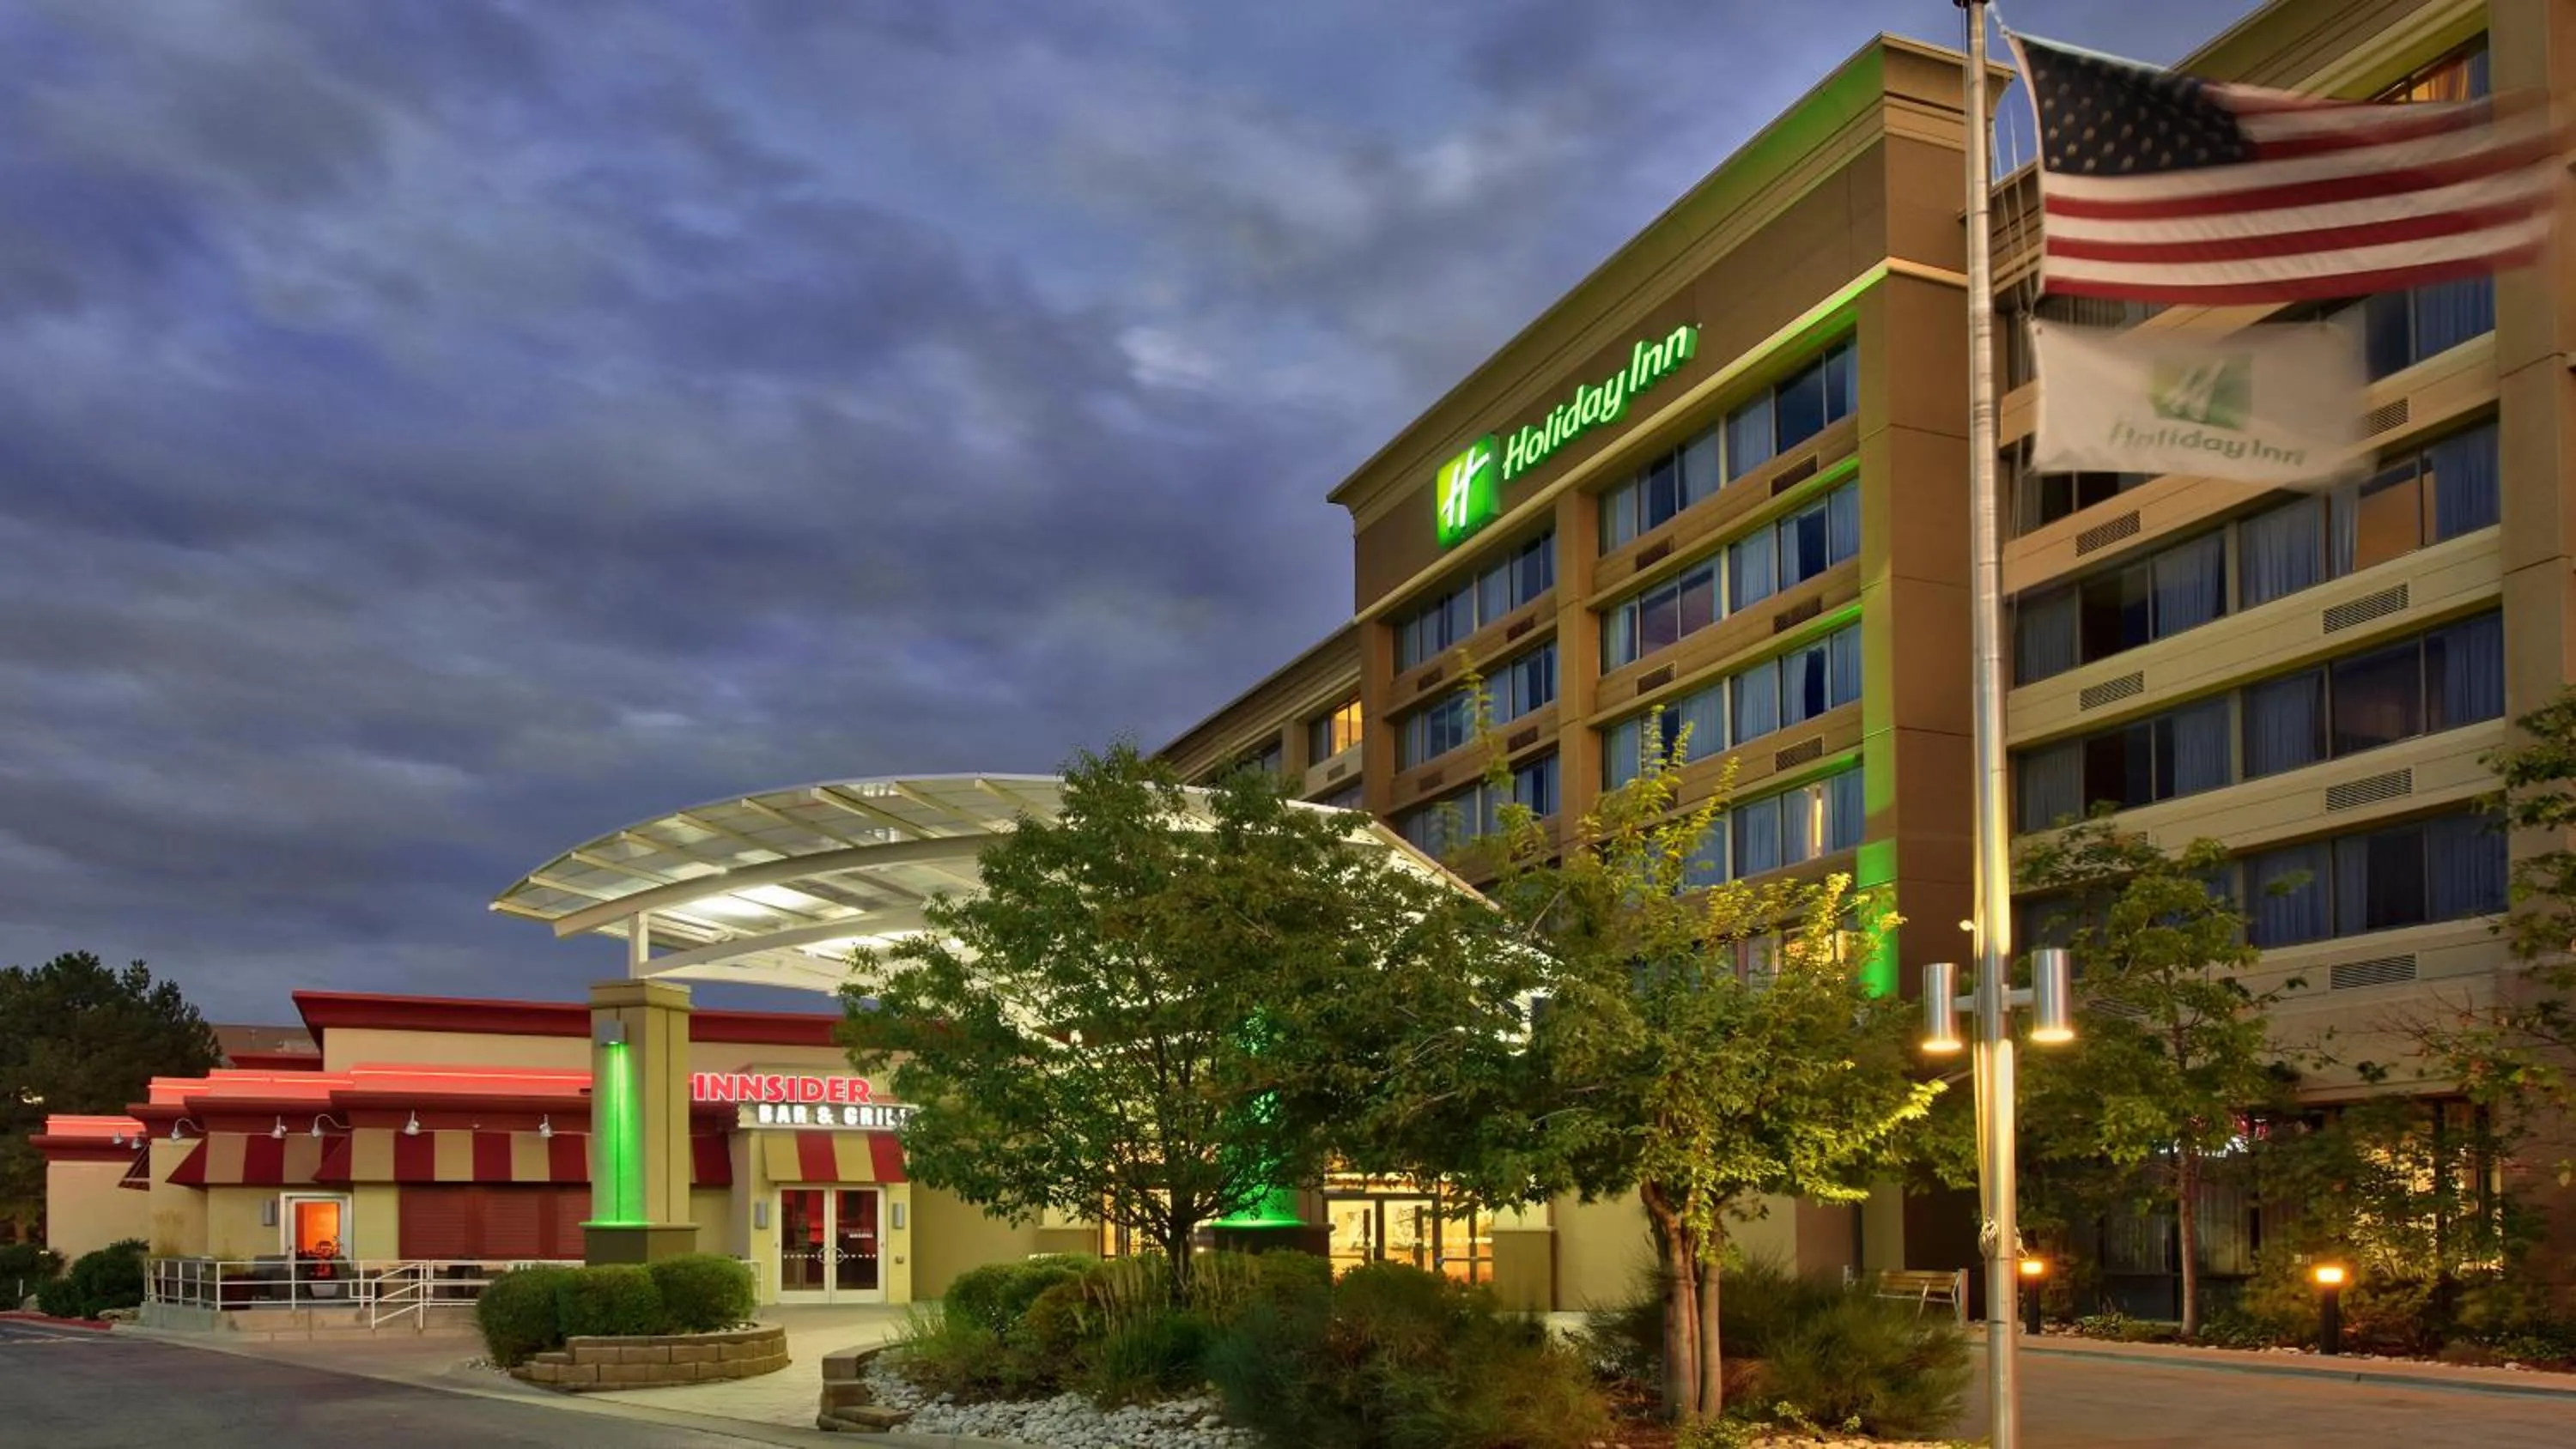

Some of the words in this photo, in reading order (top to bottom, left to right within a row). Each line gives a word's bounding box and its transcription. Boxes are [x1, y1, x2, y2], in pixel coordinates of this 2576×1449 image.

[1503, 370, 1625, 480] Holiday
[1629, 324, 1692, 392] Inn
[692, 1072, 872, 1104] INNSIDER
[758, 1104, 807, 1125] BAR
[816, 1106, 834, 1125] &
